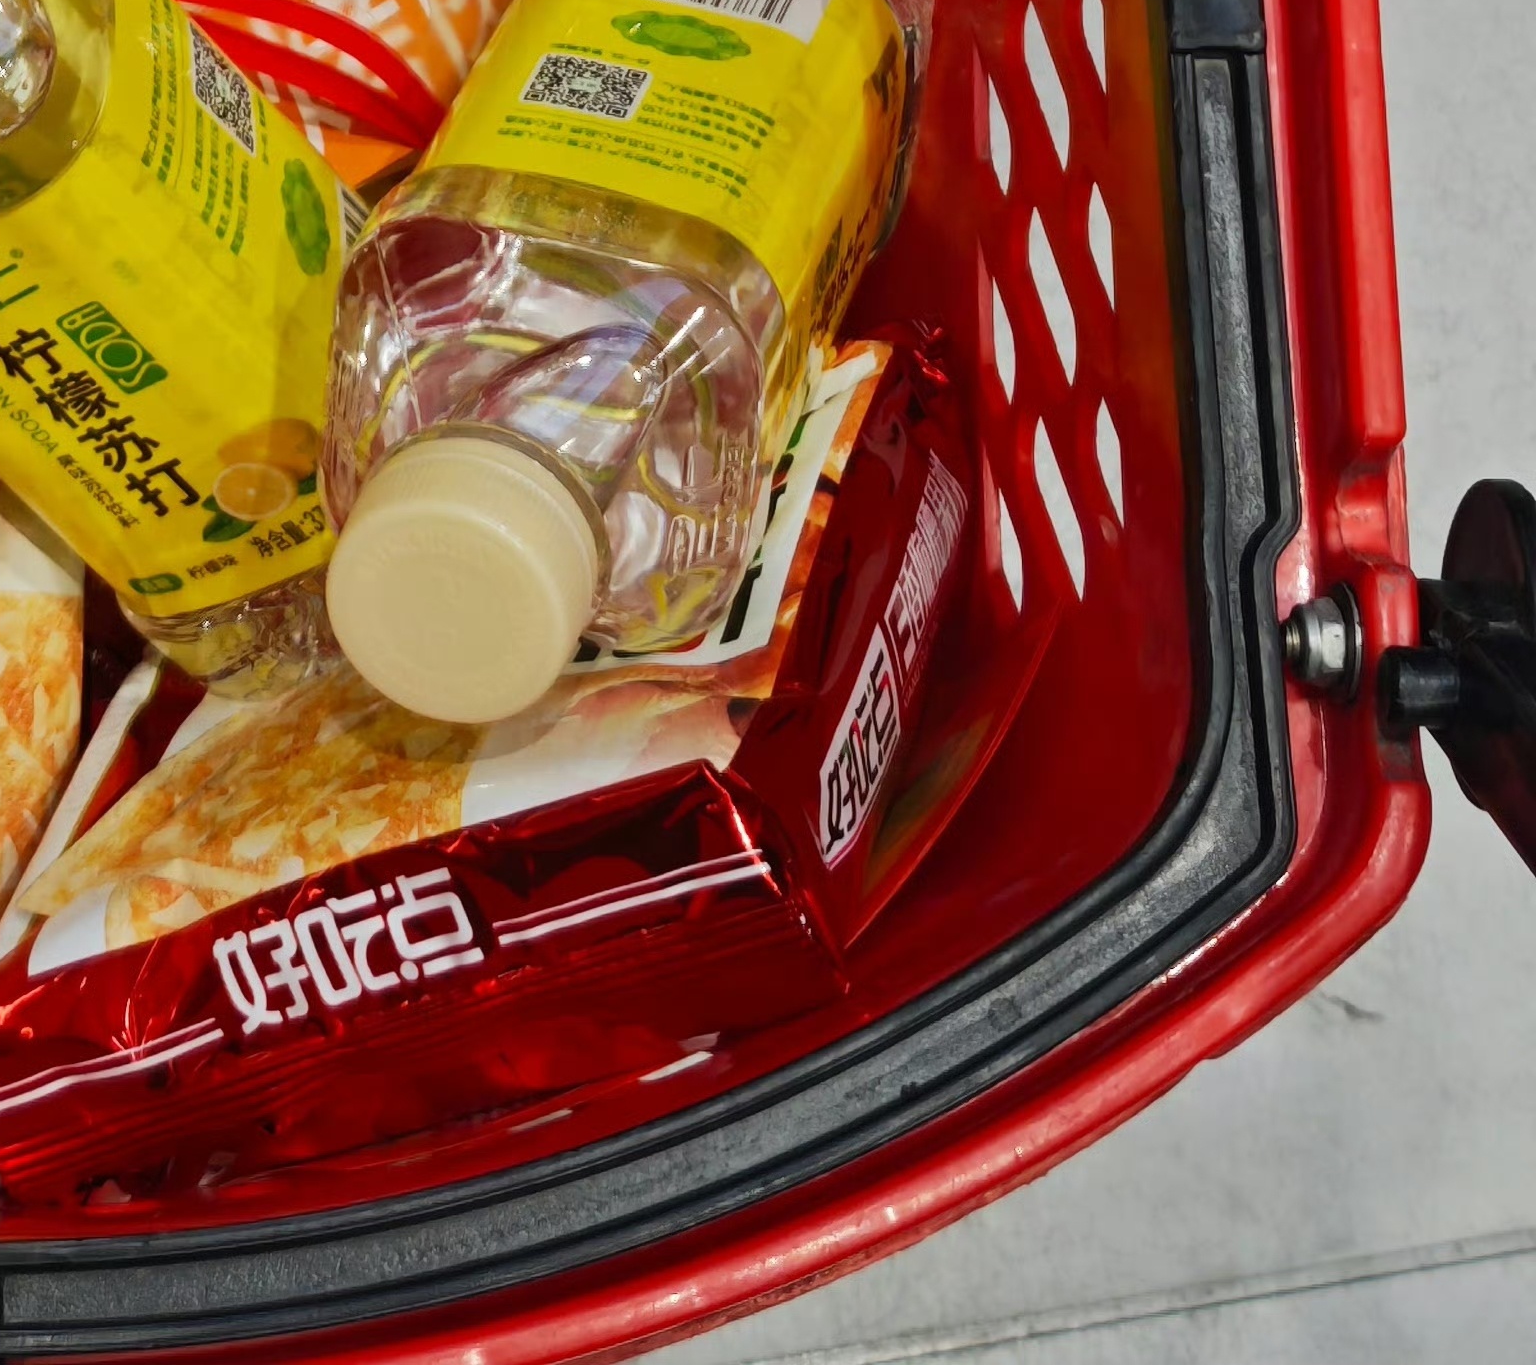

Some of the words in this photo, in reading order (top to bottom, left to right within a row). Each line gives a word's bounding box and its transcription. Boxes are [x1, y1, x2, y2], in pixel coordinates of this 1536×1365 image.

[61, 304, 164, 392] SODA
[8, 405, 59, 457] SODA
[213, 867, 485, 1035] 好吃点
